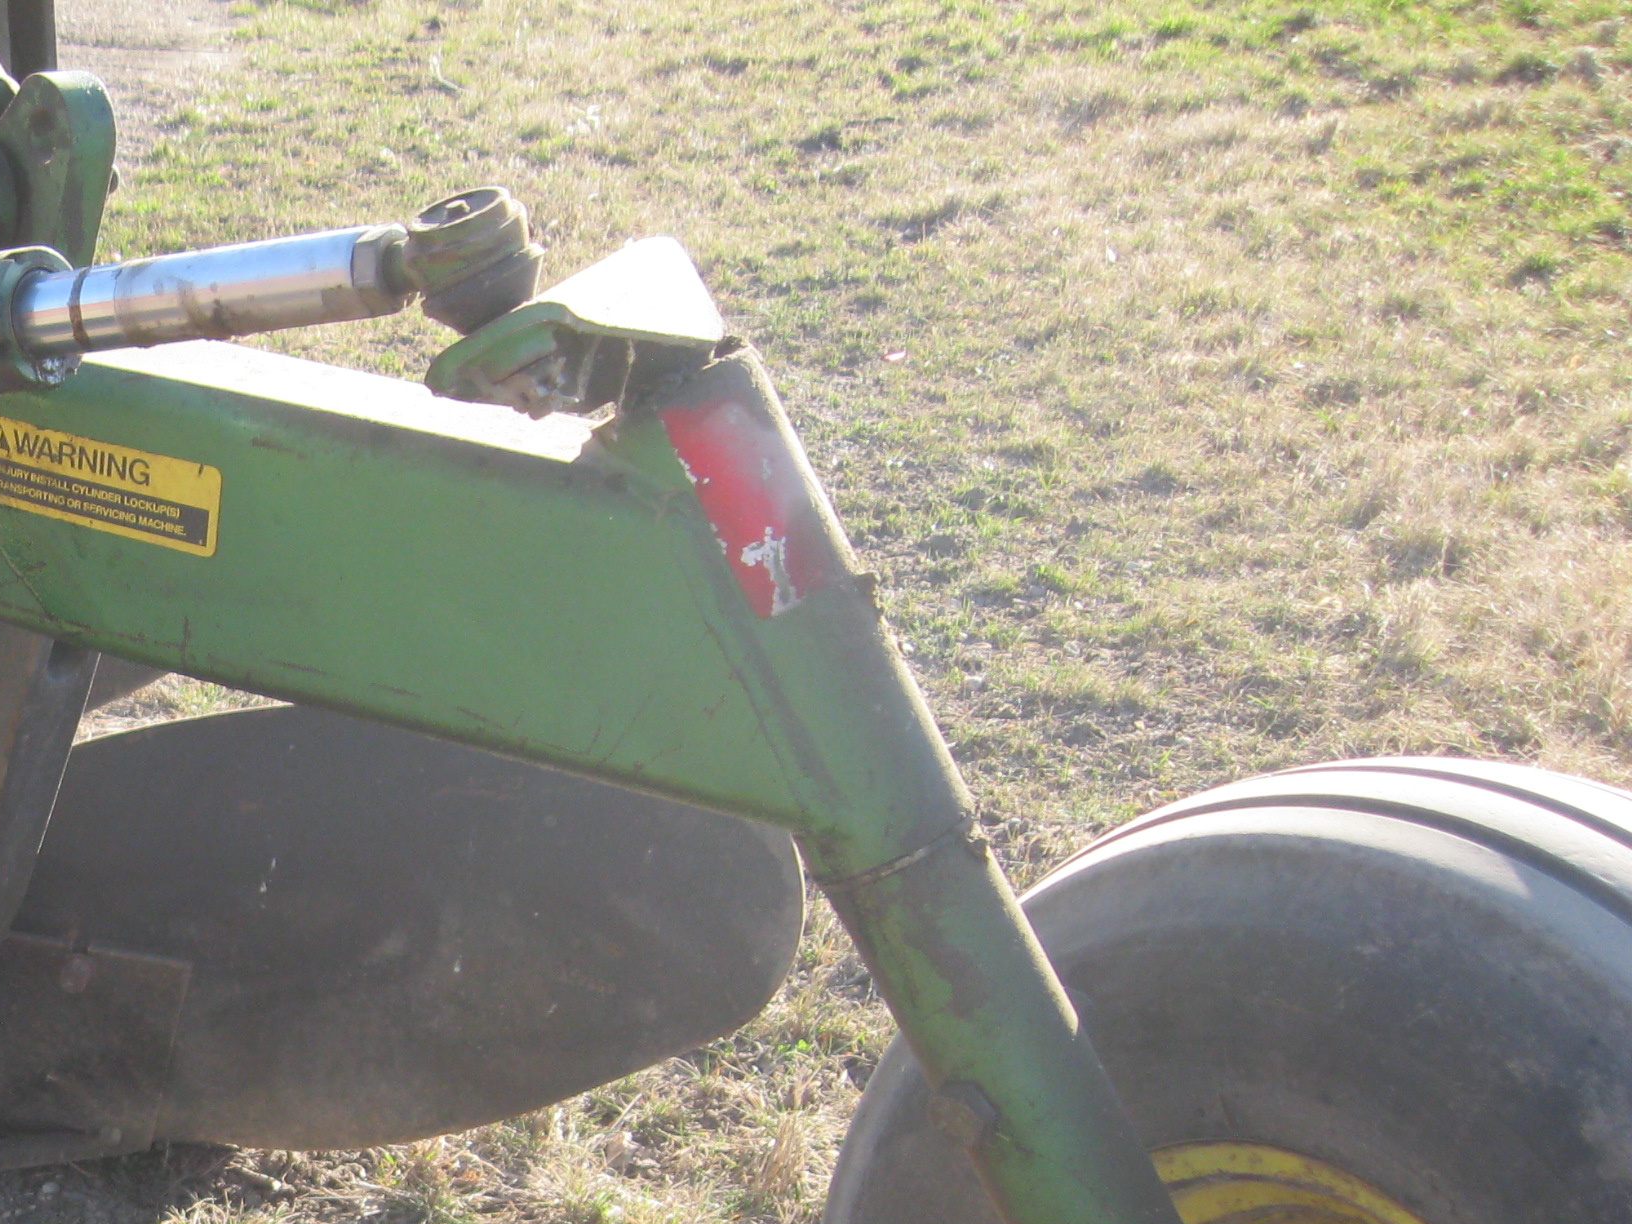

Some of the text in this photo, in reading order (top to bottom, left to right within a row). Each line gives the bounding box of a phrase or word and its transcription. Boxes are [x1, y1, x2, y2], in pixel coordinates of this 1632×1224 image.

[13, 429, 150, 486] WARNING
[30, 472, 70, 491] INSTALL
[71, 483, 121, 504] CYLINDER
[124, 496, 180, 518] LOCKUP(S)
[67, 498, 82, 511] OR
[83, 502, 137, 523] SERVICING
[138, 515, 187, 536] MACHINE.
